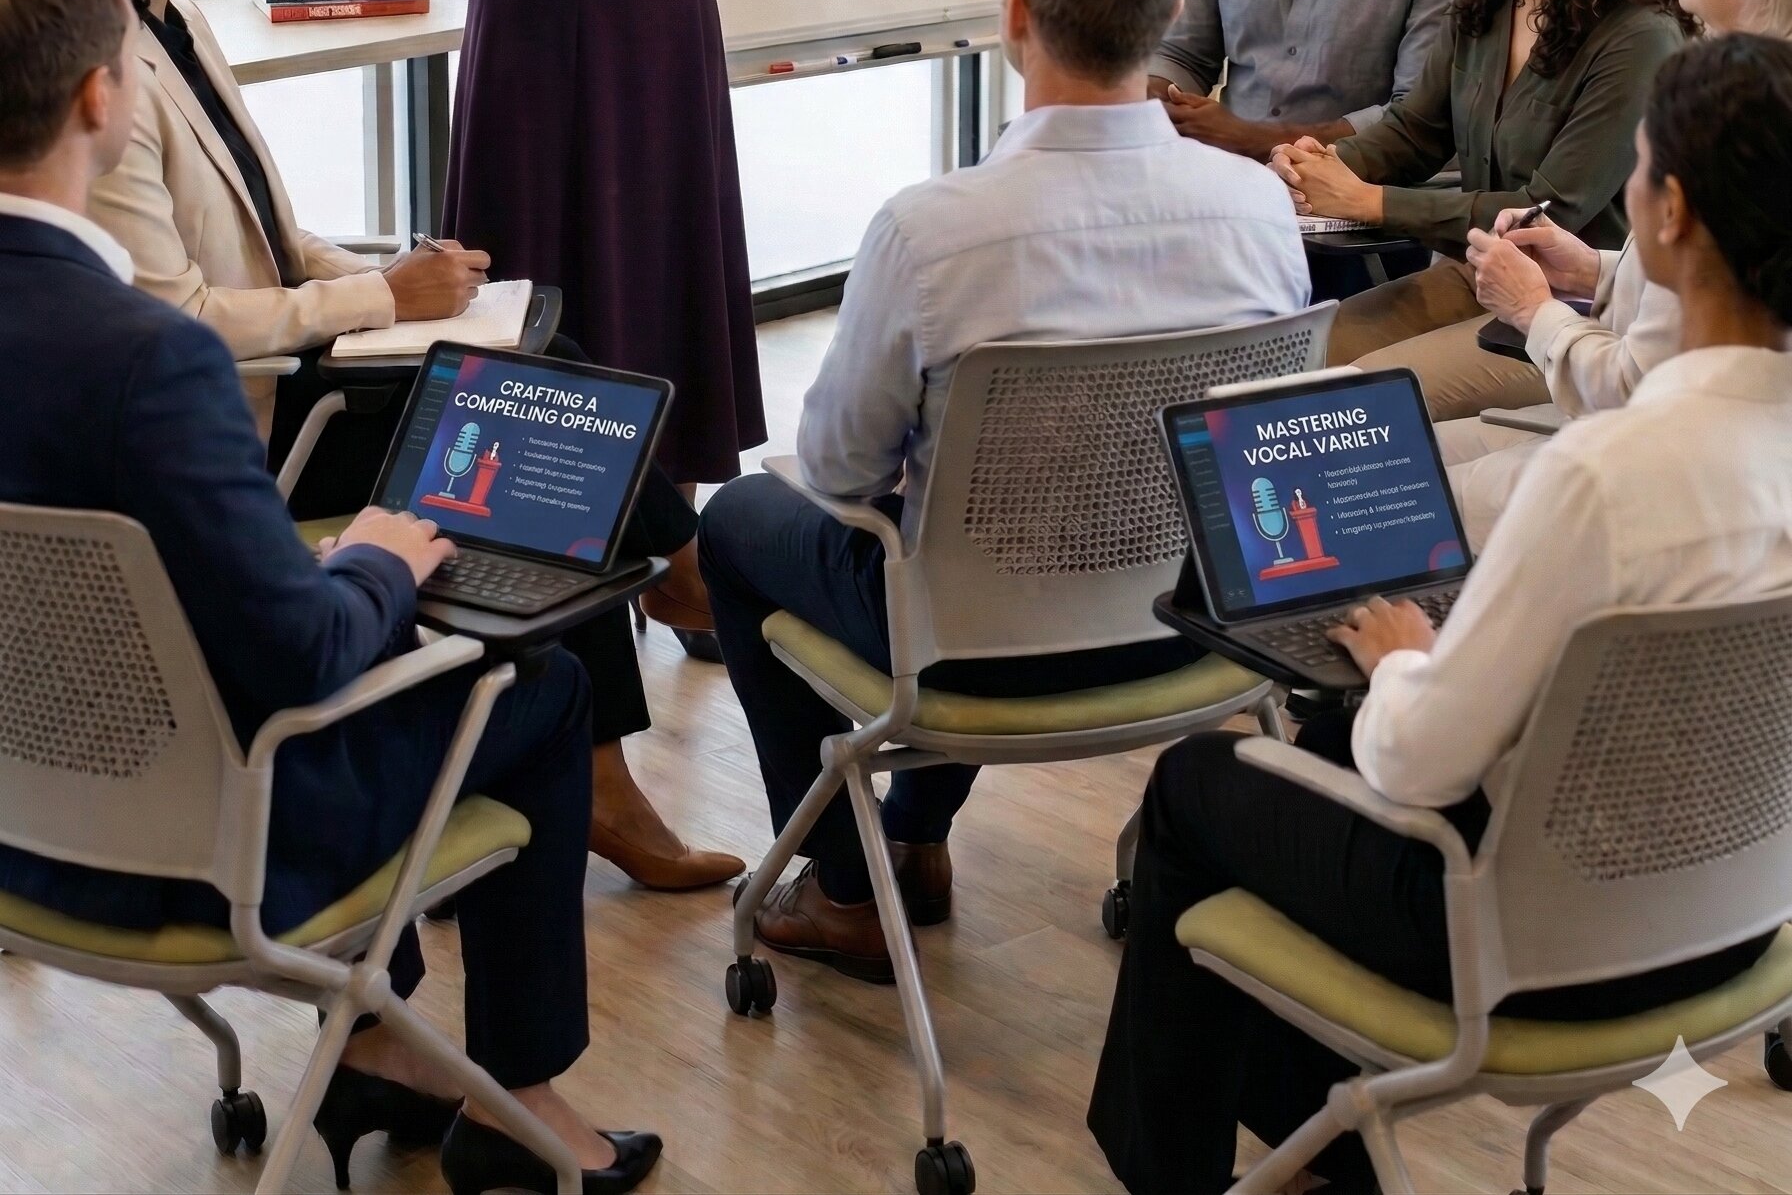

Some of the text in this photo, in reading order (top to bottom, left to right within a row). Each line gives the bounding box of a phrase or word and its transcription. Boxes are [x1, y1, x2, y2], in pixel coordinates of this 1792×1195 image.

[500, 380, 598, 412] CRAFTING A
[454, 392, 637, 440] COMPELLING OPENING
[1256, 408, 1367, 441] MASTERING
[1243, 425, 1390, 466] VOCAL VARIETY
